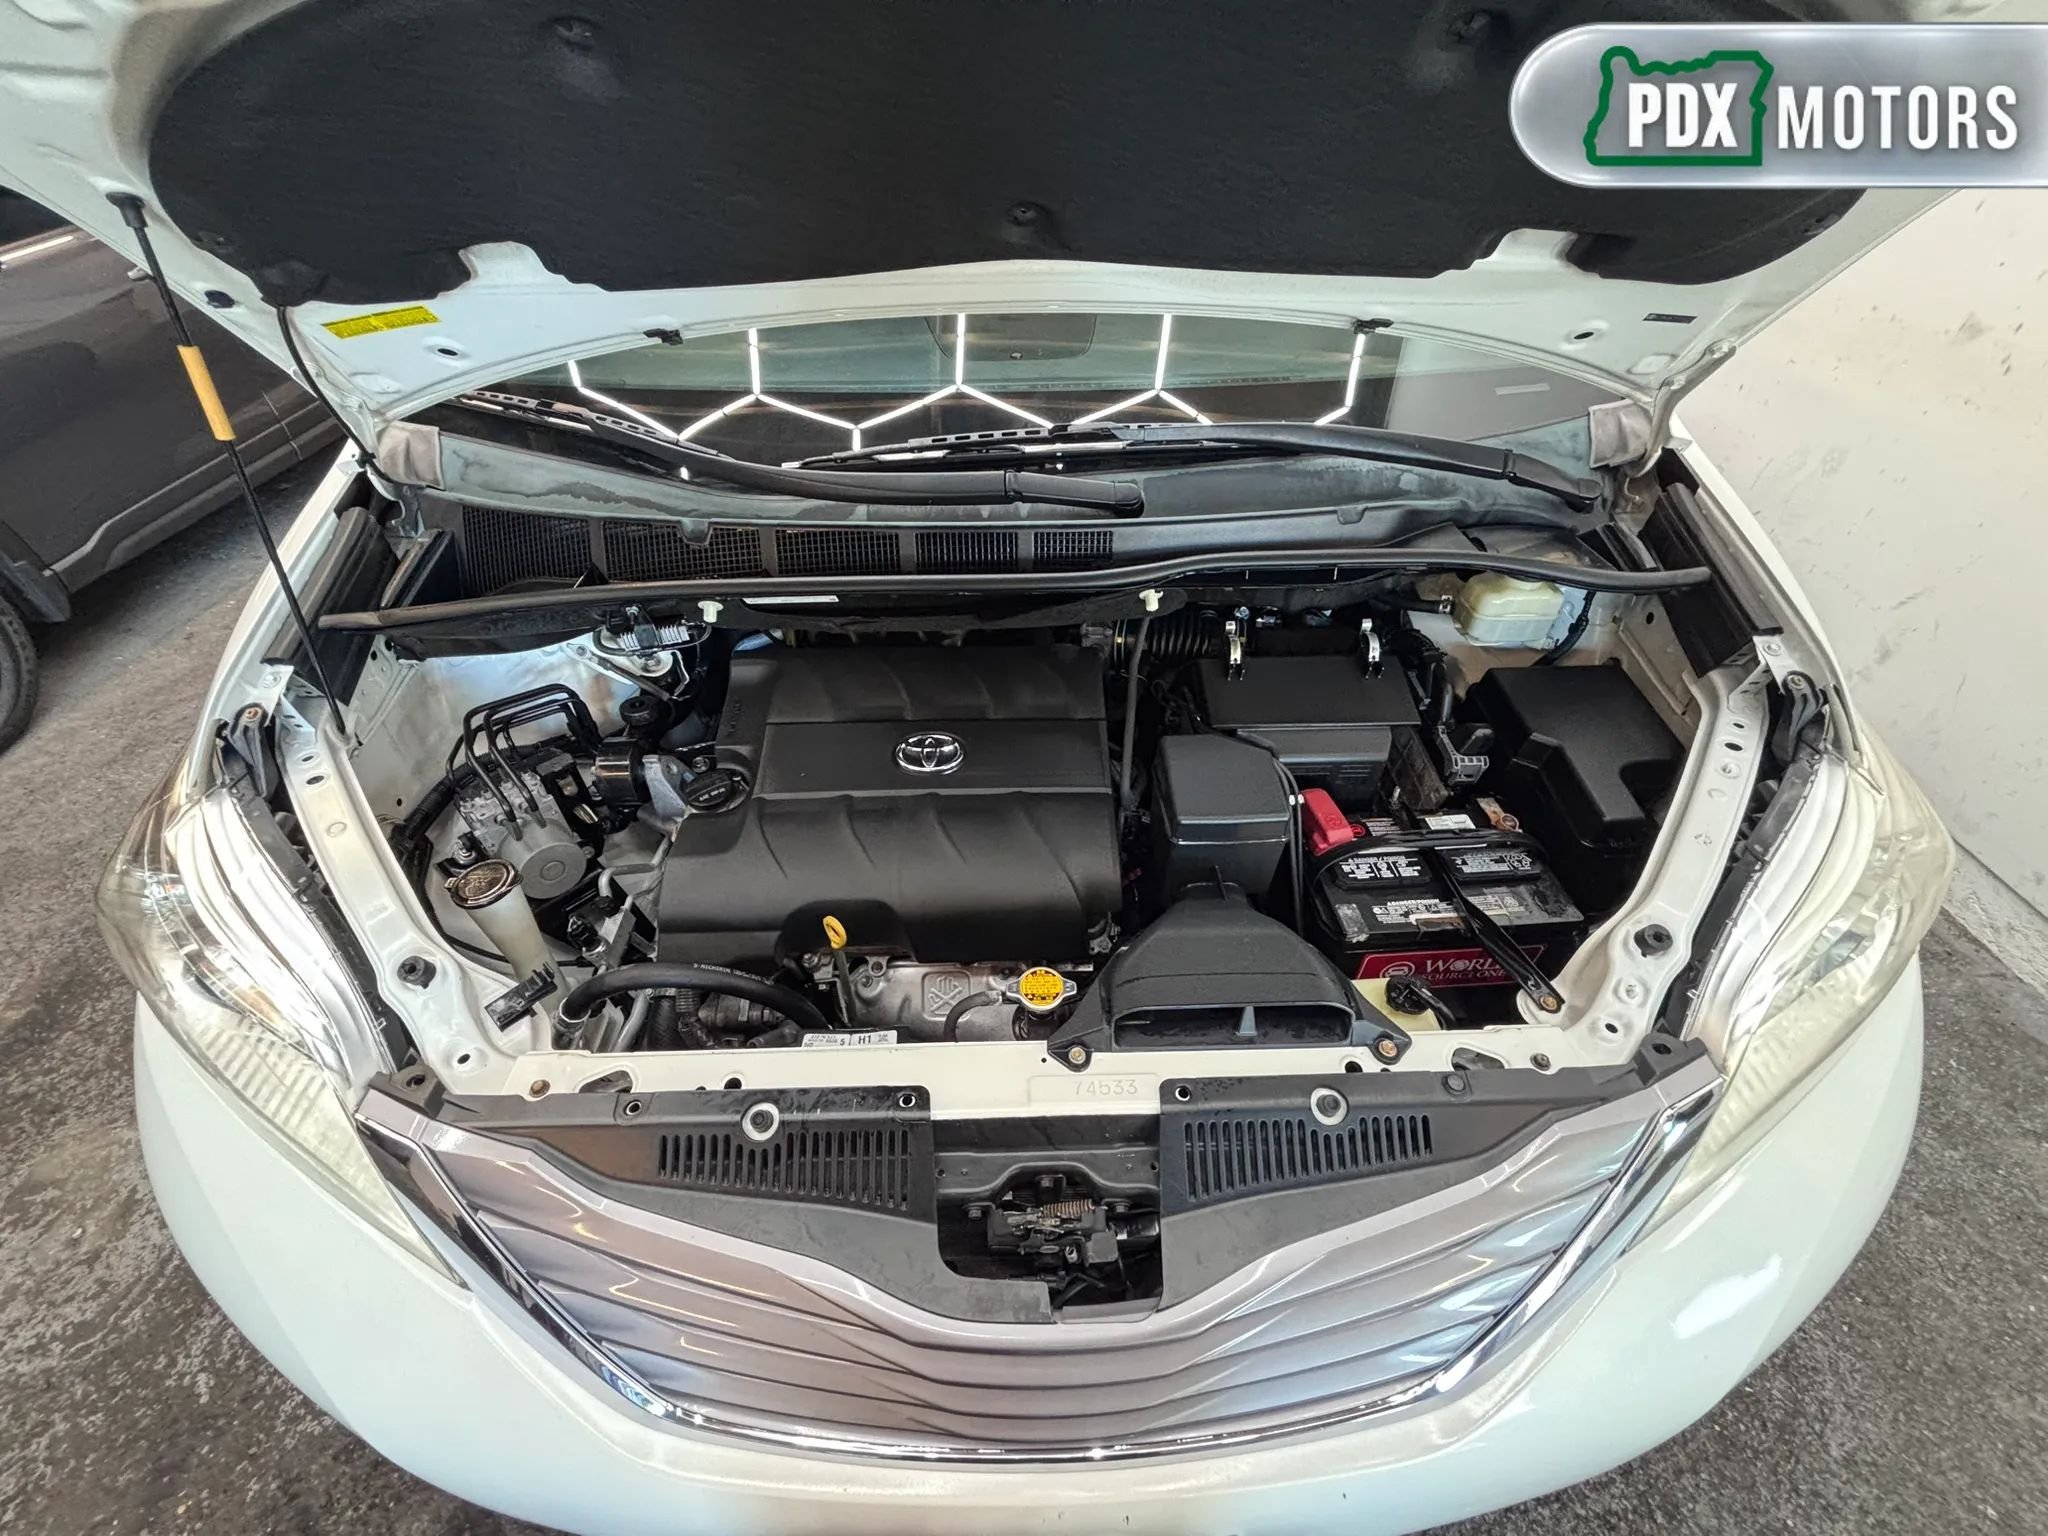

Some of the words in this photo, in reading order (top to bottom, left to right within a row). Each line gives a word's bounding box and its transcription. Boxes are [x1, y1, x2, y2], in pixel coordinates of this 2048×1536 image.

[1426, 958, 1503, 973] WORL
[858, 1035, 872, 1045] H1
[1075, 1080, 1138, 1096] 74533
